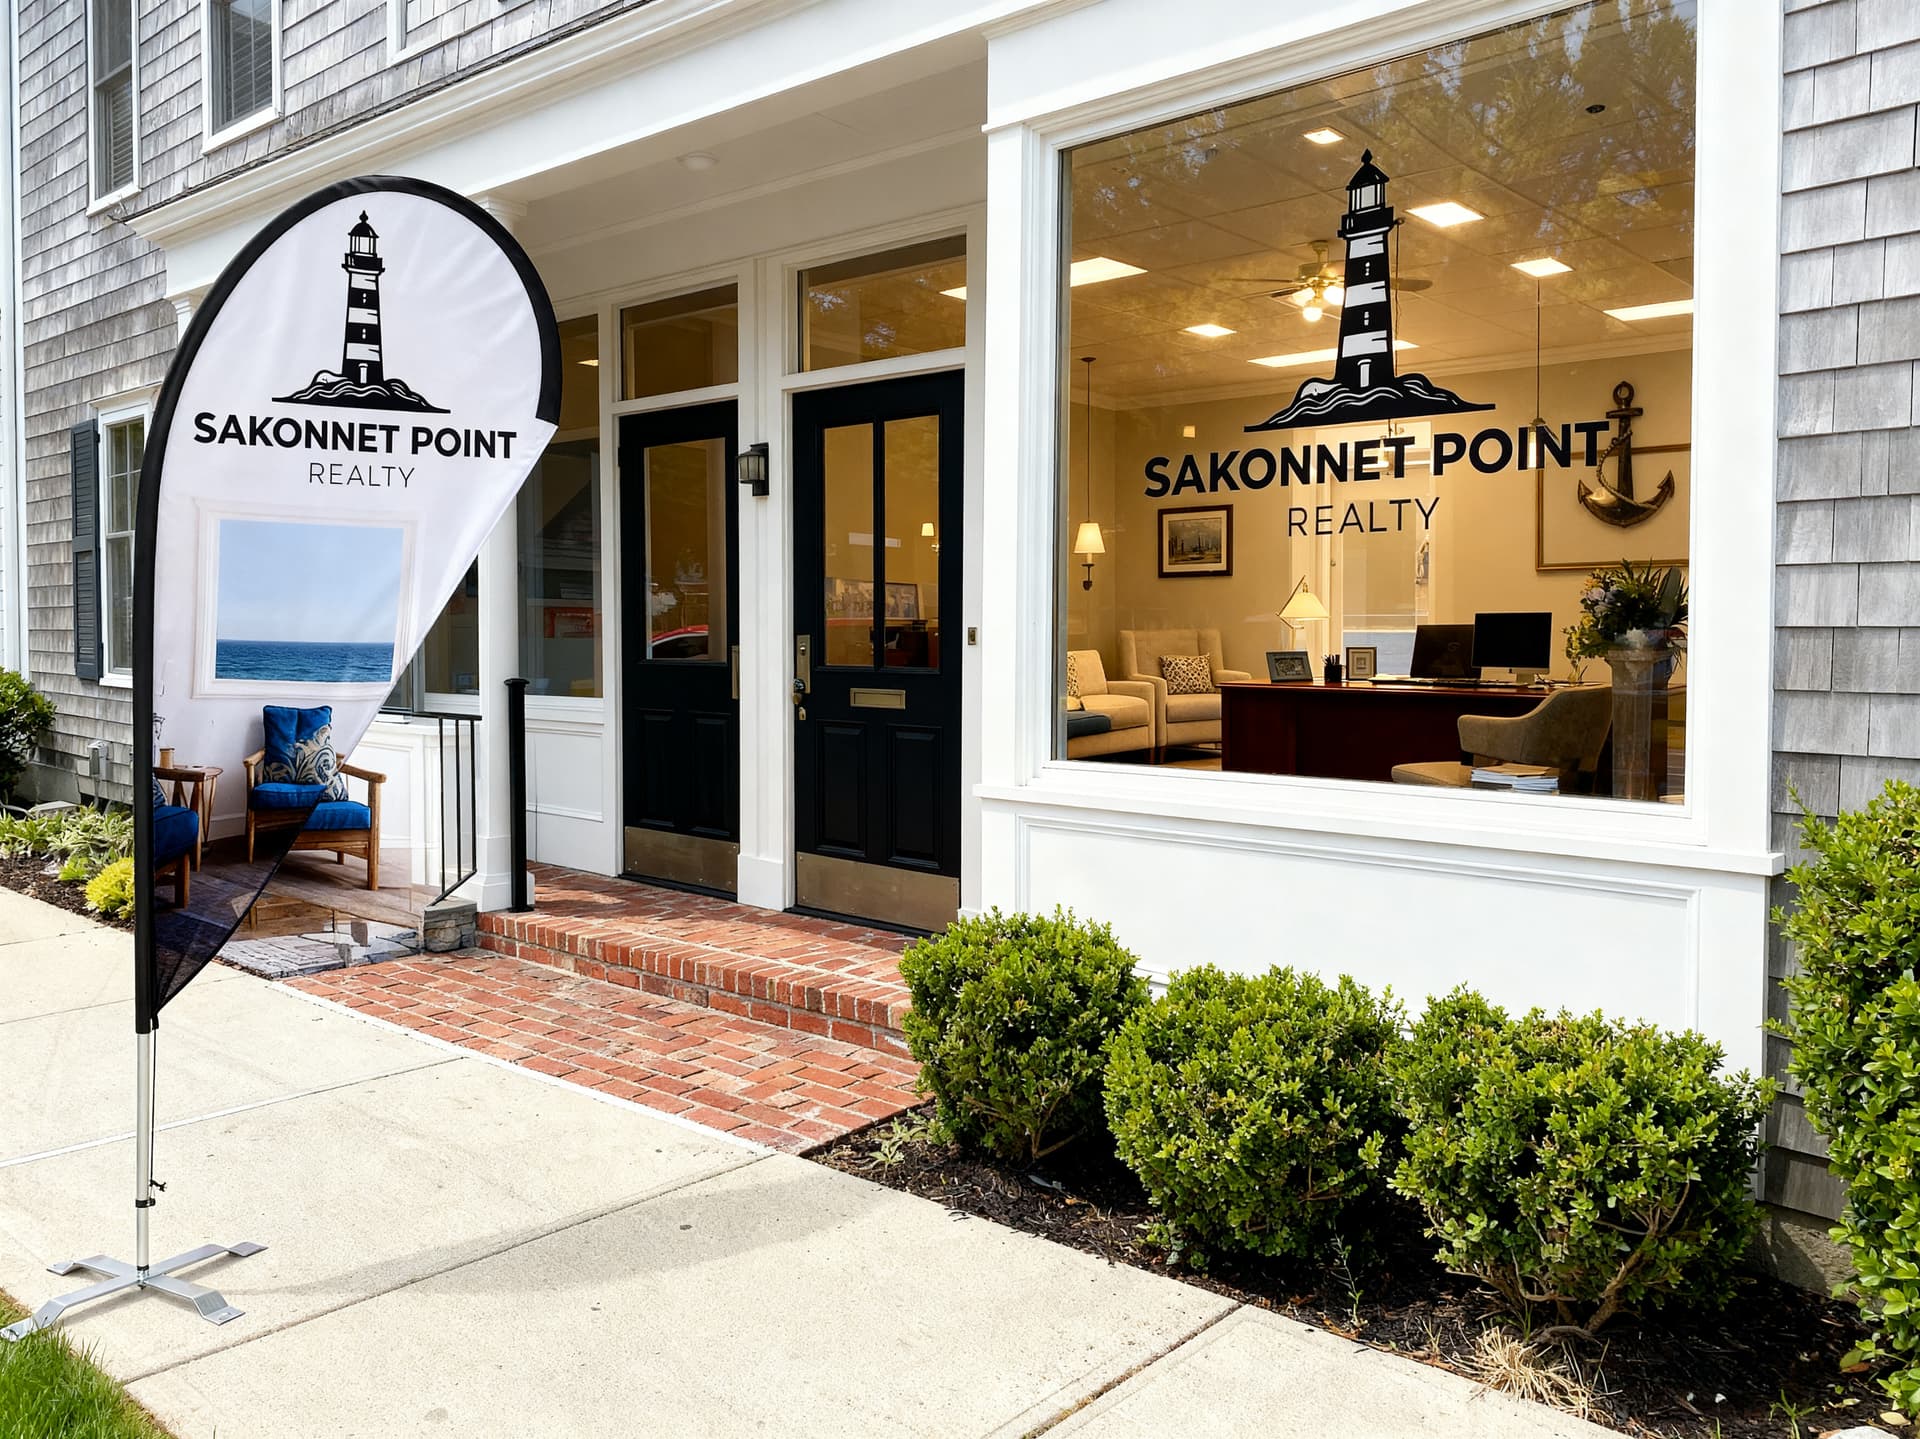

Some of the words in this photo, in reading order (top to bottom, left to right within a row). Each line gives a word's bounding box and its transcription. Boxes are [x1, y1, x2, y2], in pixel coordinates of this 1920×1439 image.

[194, 412, 400, 454] SAKONNET
[411, 426, 517, 459] POINT
[309, 463, 415, 488] REALTY
[1144, 436, 1416, 498] SAKONNET
[1433, 420, 1610, 476] POINT
[1288, 497, 1440, 537] REALTY
